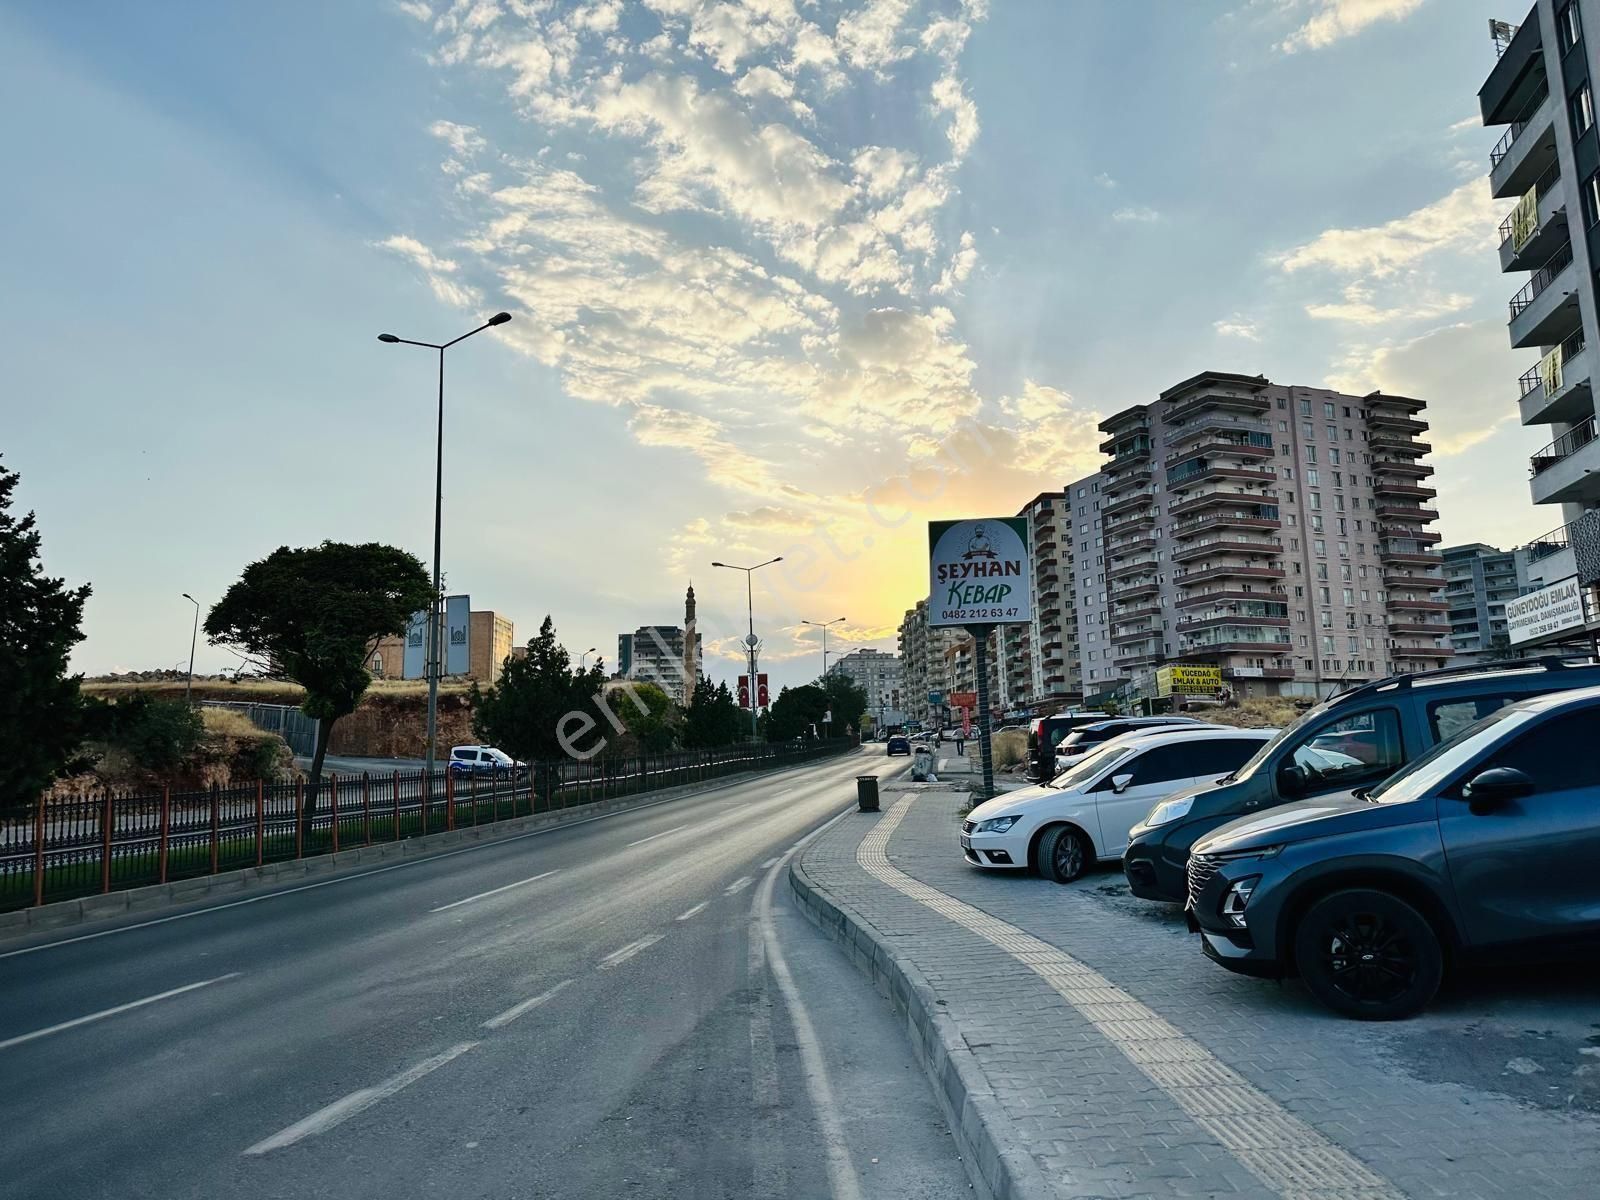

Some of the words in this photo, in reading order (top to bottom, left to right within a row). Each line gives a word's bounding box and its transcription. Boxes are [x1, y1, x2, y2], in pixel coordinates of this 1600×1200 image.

[937, 560, 1021, 584] ŞEYHAN
[948, 580, 1012, 609] KEBAP
[1507, 592, 1549, 619] GÜNEYDOĞU
[1550, 583, 1577, 604] EMLAK
[942, 610, 966, 619] 0482
[969, 609, 988, 619] 212
[990, 608, 1003, 617] 63
[1006, 607, 1019, 617] 47
[1202, 678, 1219, 686] AUTO
